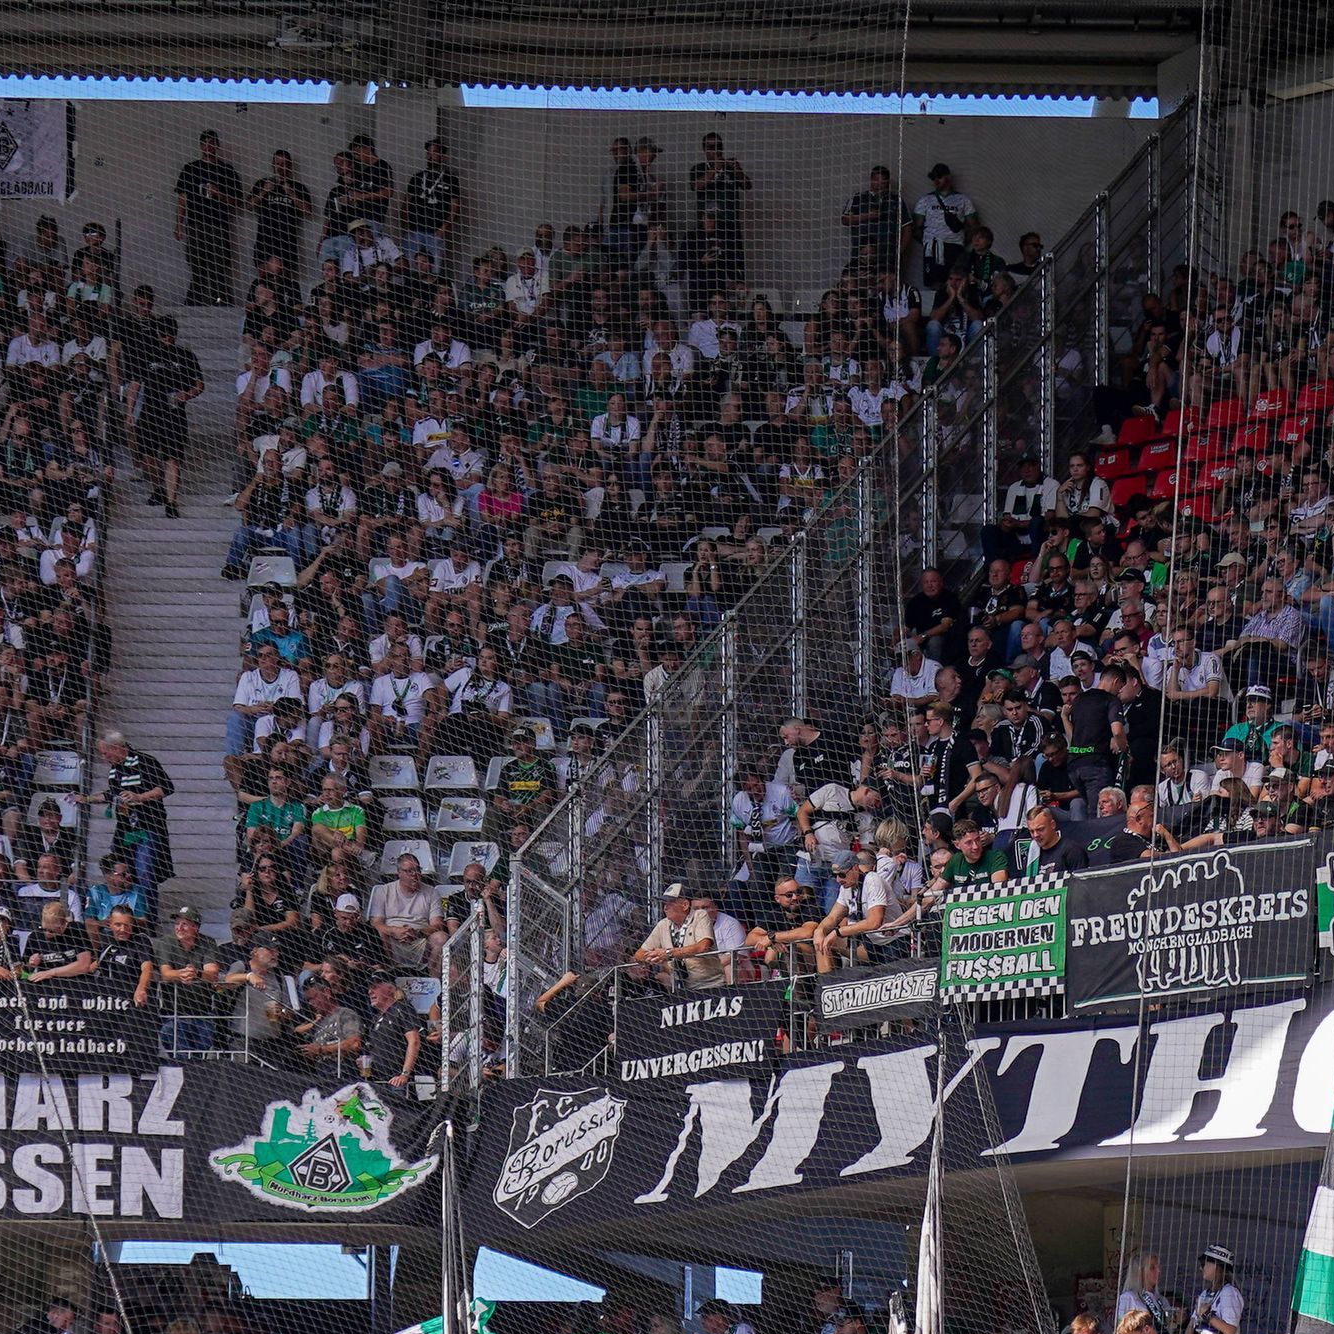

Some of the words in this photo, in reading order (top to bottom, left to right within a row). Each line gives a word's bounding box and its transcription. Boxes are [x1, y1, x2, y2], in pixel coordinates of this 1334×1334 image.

[948, 901, 1011, 931] GEGEN
[1012, 894, 1061, 920] DEN
[1071, 888, 1310, 948] FREUNDESKREIS
[949, 923, 1056, 955] MODERNEN
[1127, 924, 1255, 956] MÖNCHENGLADBACH
[37, 994, 69, 1011] and
[81, 995, 131, 1011] white
[660, 995, 744, 1030] NIKLAS
[620, 1040, 765, 1083] UNVERGESSEN!
[503, 1104, 616, 1195] Borussia
